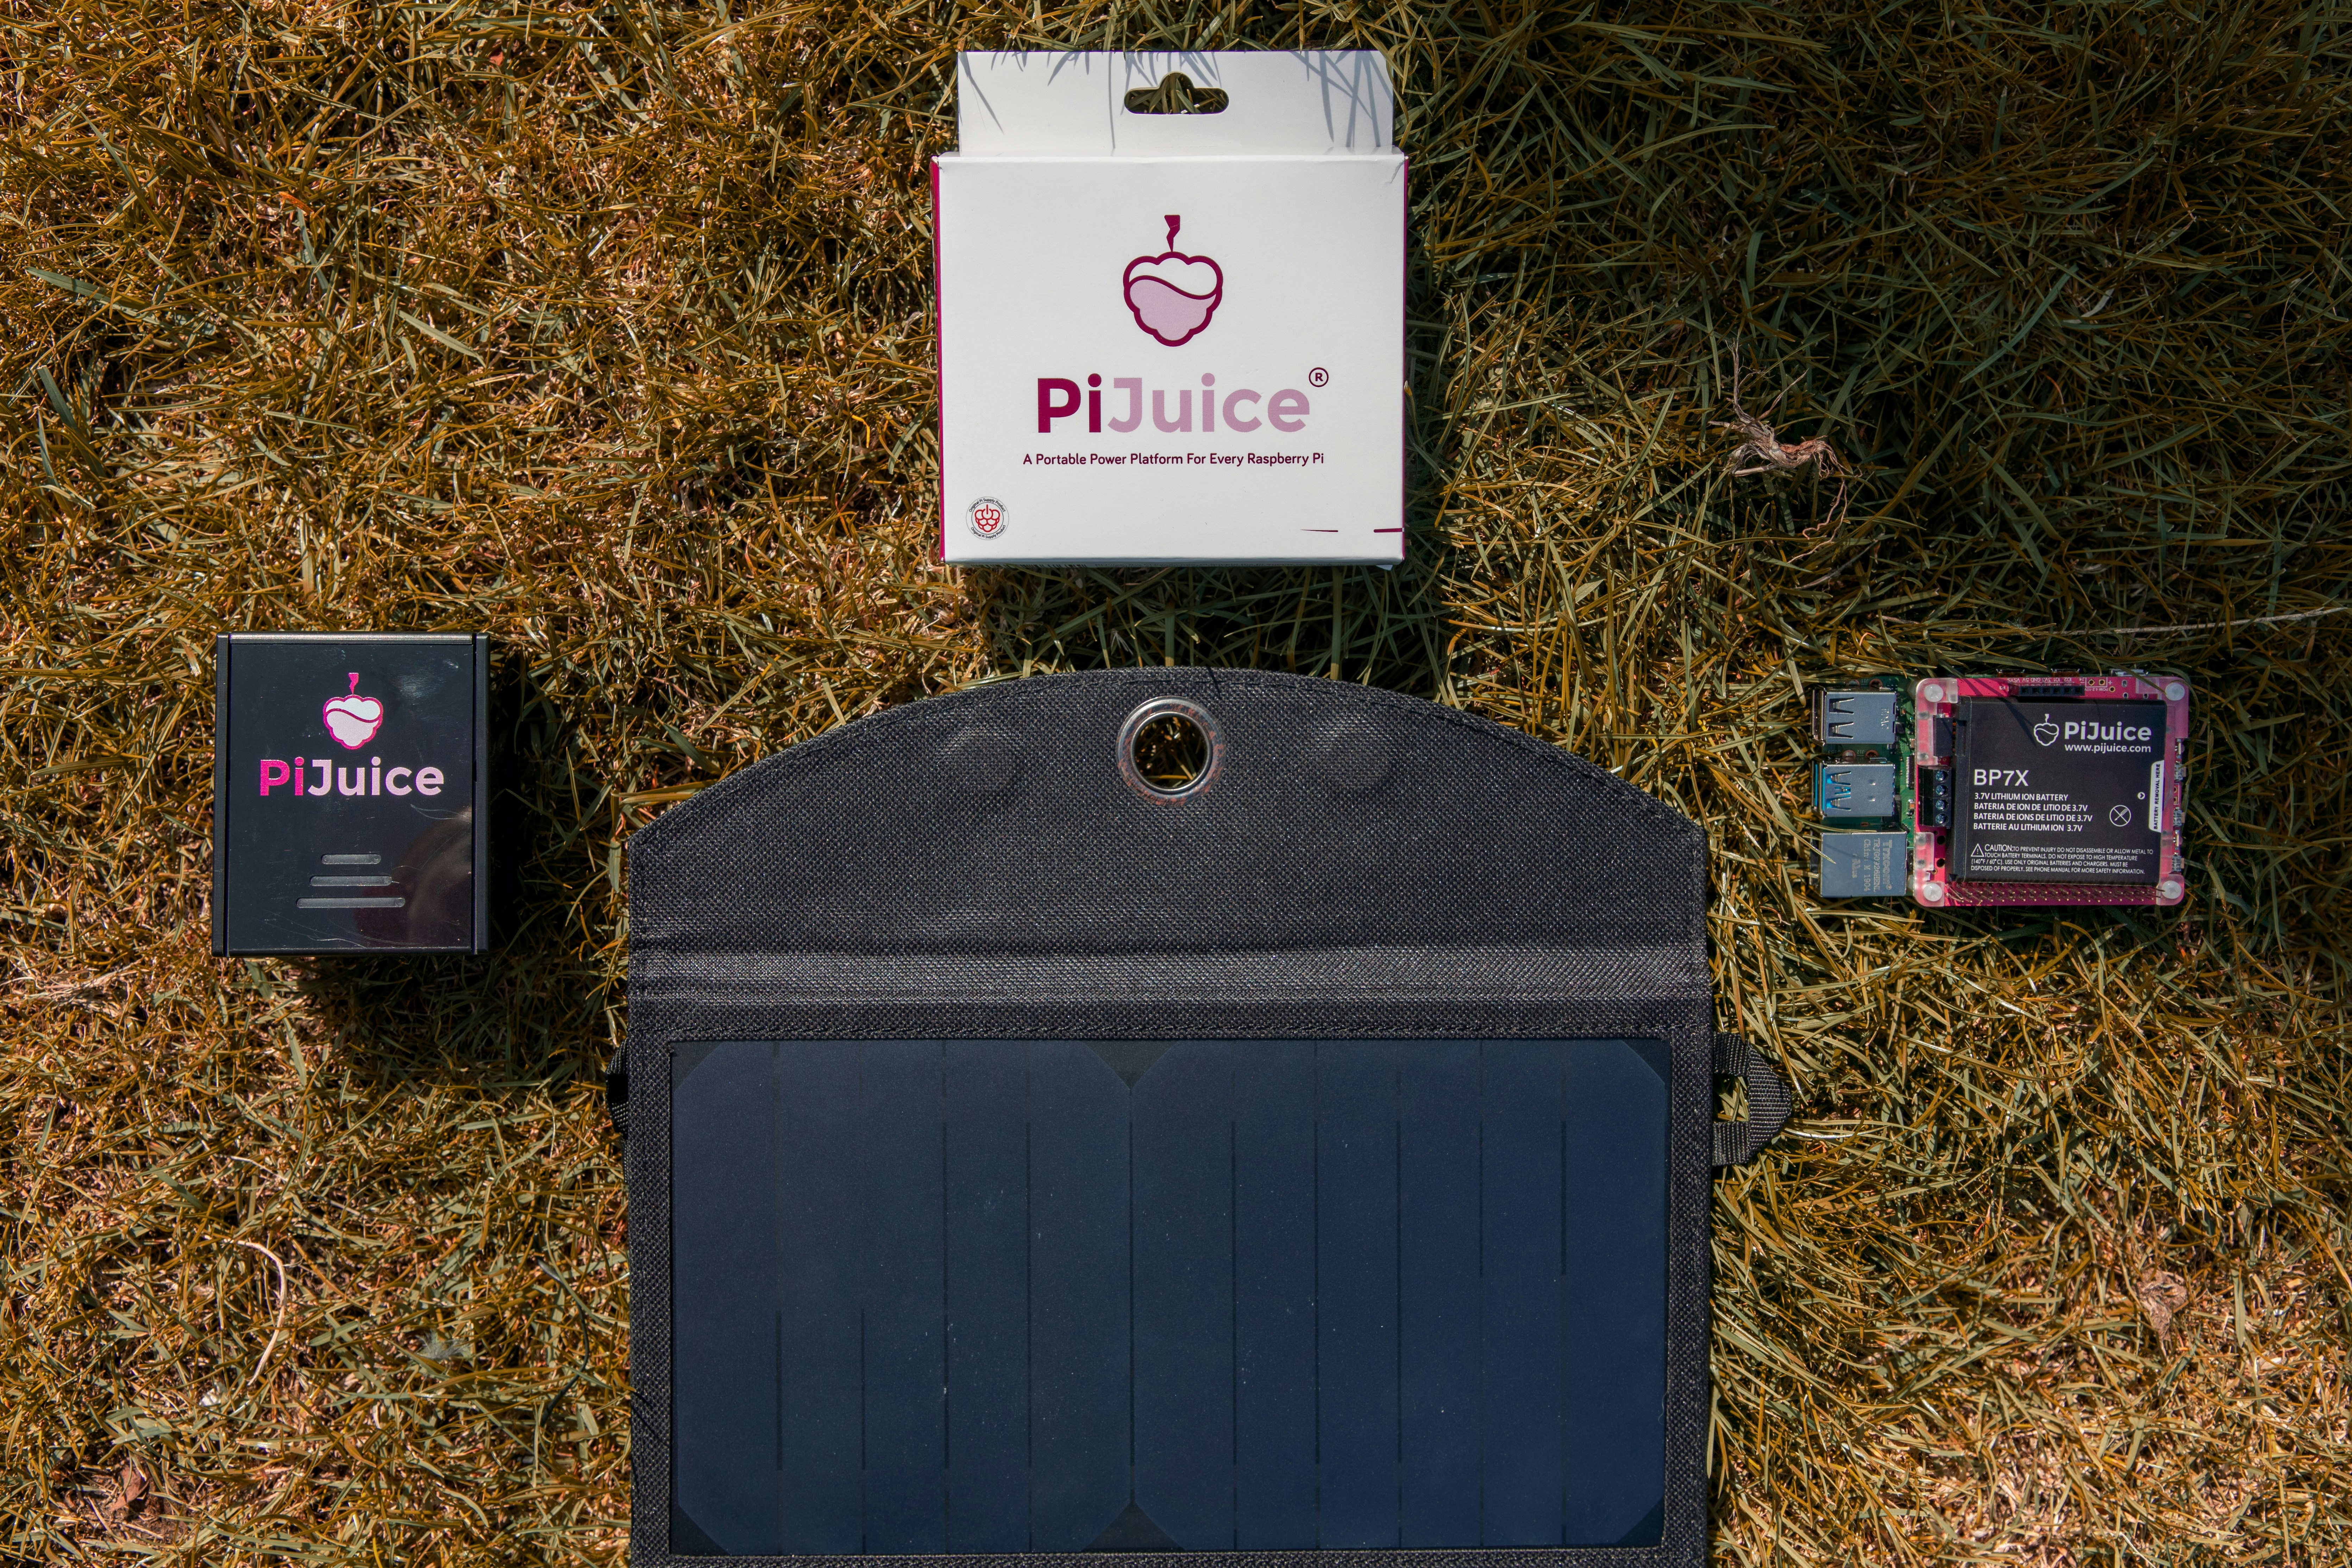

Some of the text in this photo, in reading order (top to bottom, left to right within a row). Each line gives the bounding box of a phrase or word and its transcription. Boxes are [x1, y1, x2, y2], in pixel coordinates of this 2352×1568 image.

[1023, 452, 1323, 466] A Portable Power Platform For Every Raspberry Pi
[969, 501, 979, 512] Original
[996, 501, 1005, 512] Product
[971, 527, 981, 537] Original
[996, 525, 1006, 535] Product
[2065, 721, 2151, 740] PiJuice
[2065, 743, 2151, 753] www.pijuice.com
[260, 757, 444, 796] PiJuice
[1975, 769, 2028, 786] BP7X
